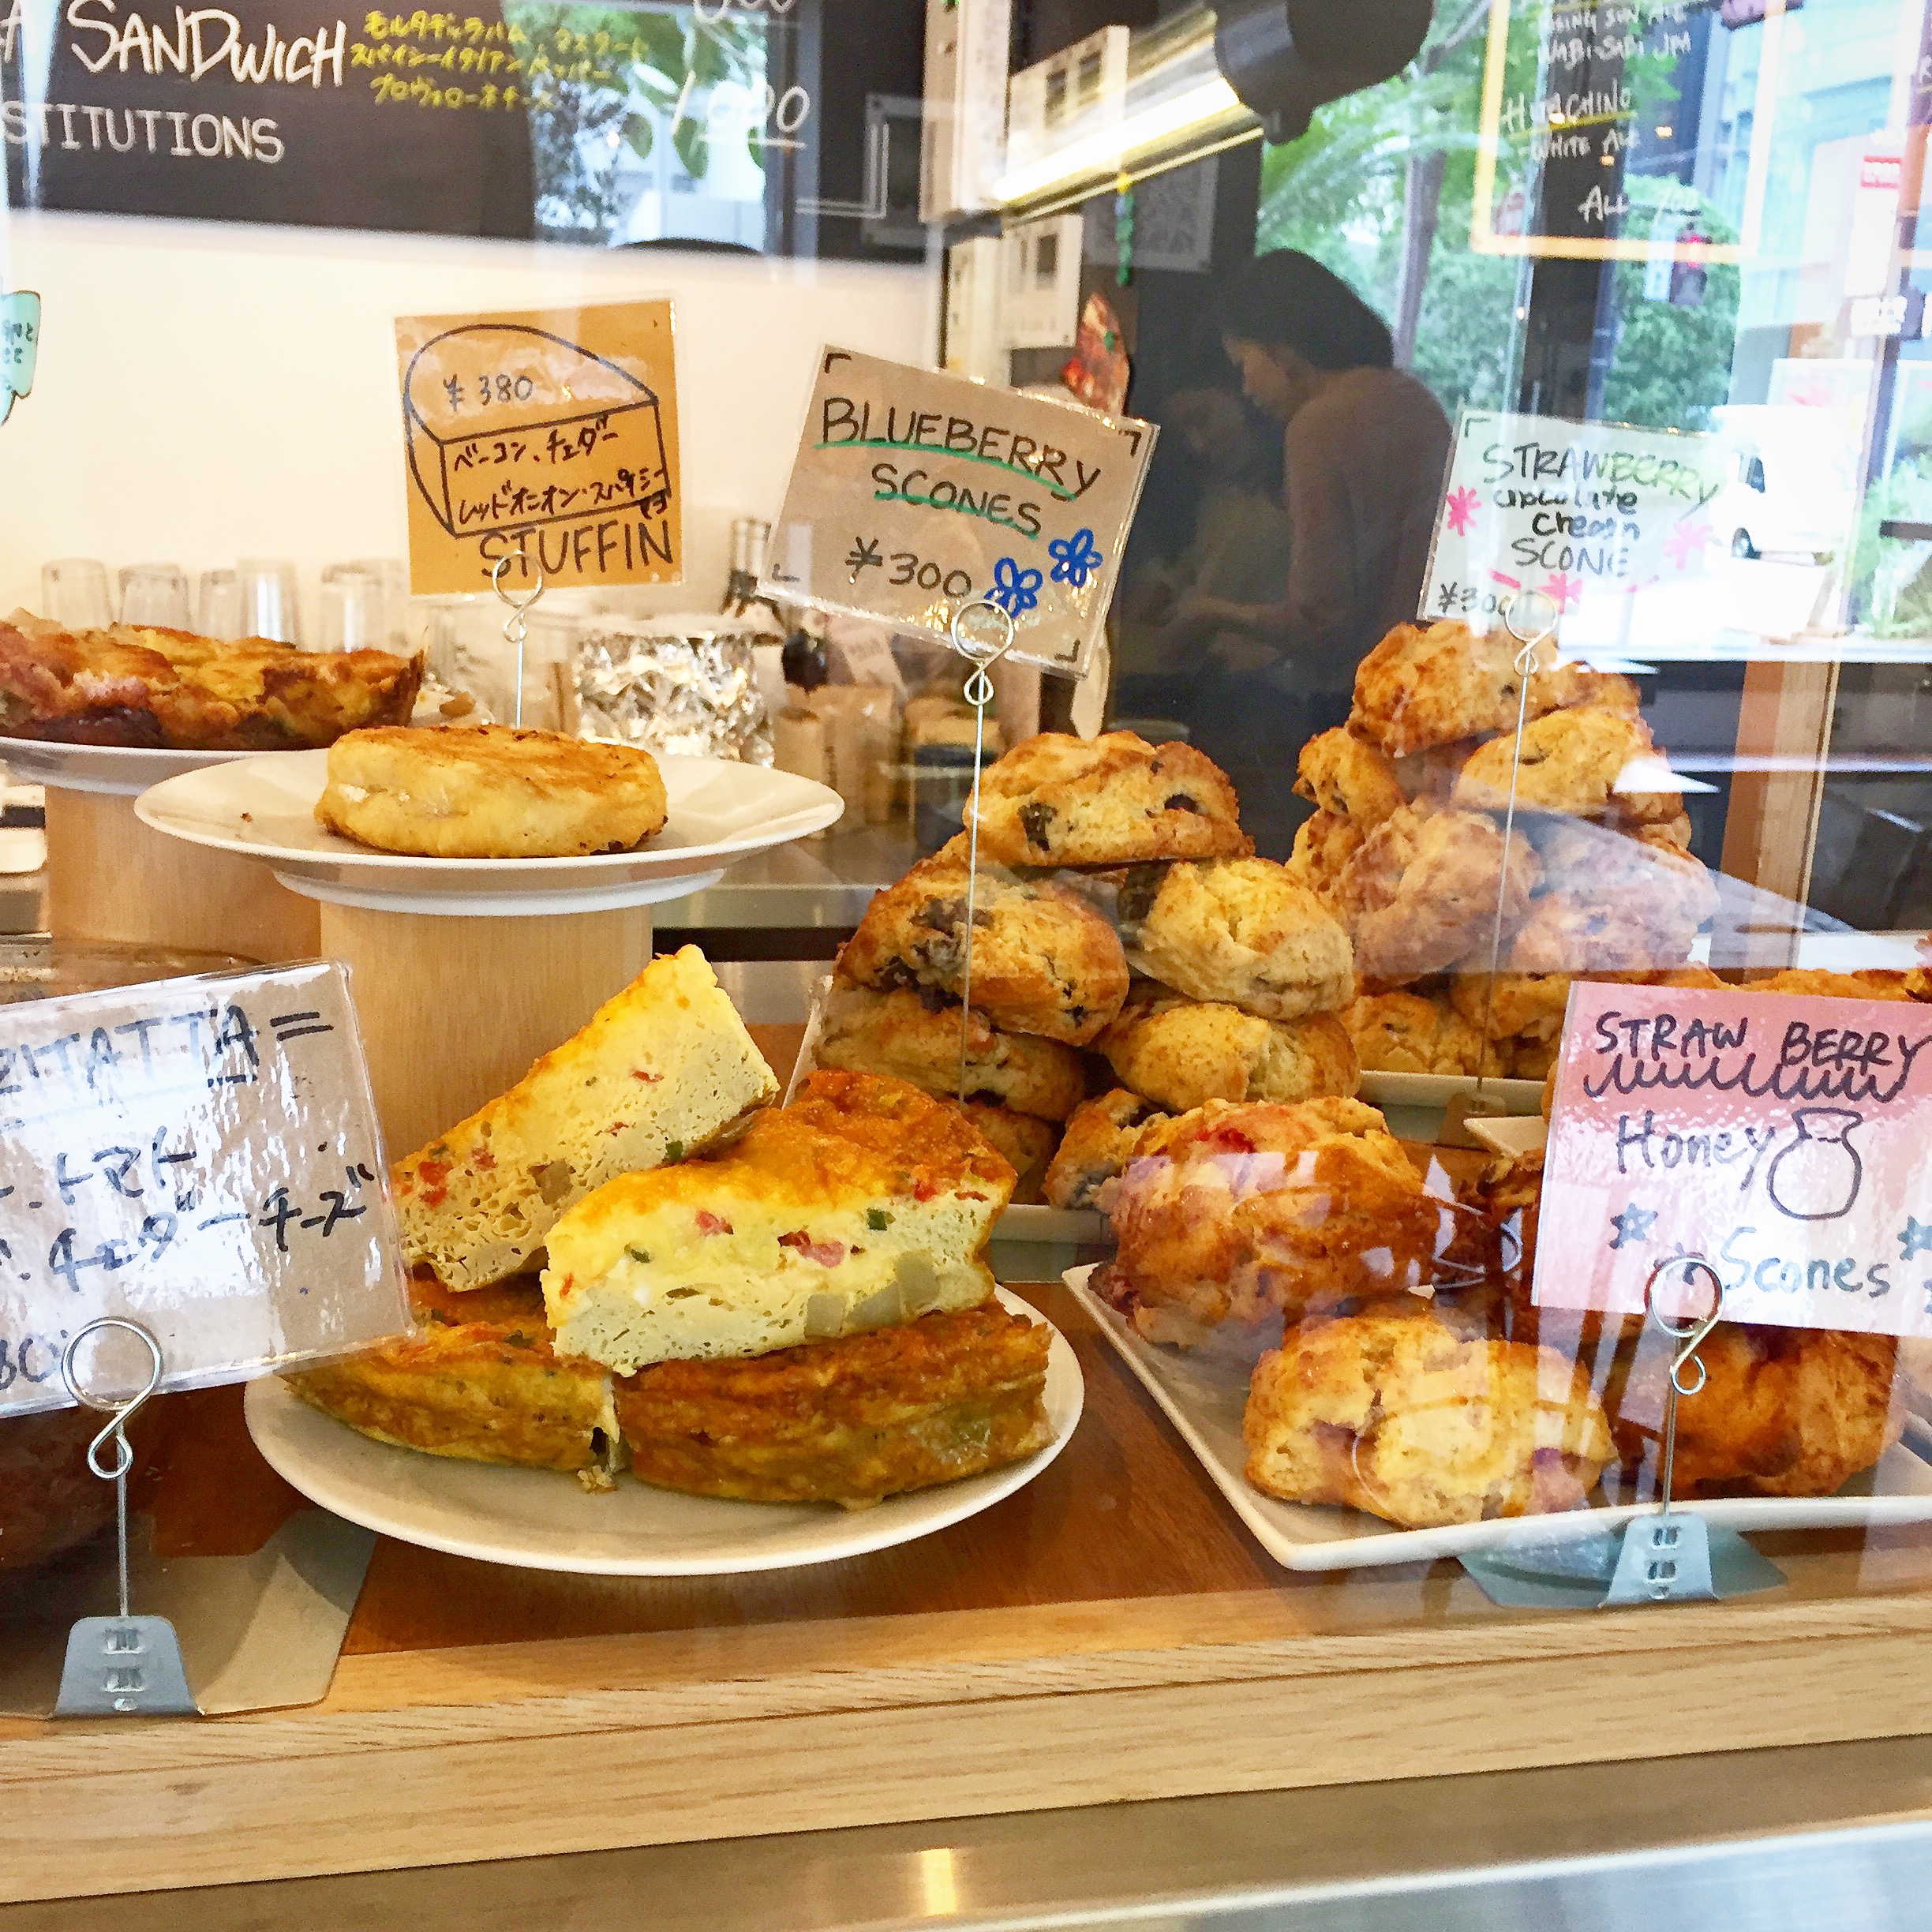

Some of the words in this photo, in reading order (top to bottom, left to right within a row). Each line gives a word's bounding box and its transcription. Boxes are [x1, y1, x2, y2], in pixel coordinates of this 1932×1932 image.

[66, 0, 346, 88] SANDWICH
[822, 396, 1102, 502] BLUEBERRY
[1482, 442, 1719, 522] STRAWBERRY
[871, 462, 1043, 537] SCONES
[478, 519, 675, 578] STUFFIN
[844, 535, 972, 599] ¥300
[1511, 537, 1629, 578] SCONE
[1595, 1010, 1749, 1061] STRAW
[1780, 1020, 1932, 1088] BERRY
[1616, 1110, 1776, 1190] Honey
[1720, 1226, 1893, 1298] Scones
